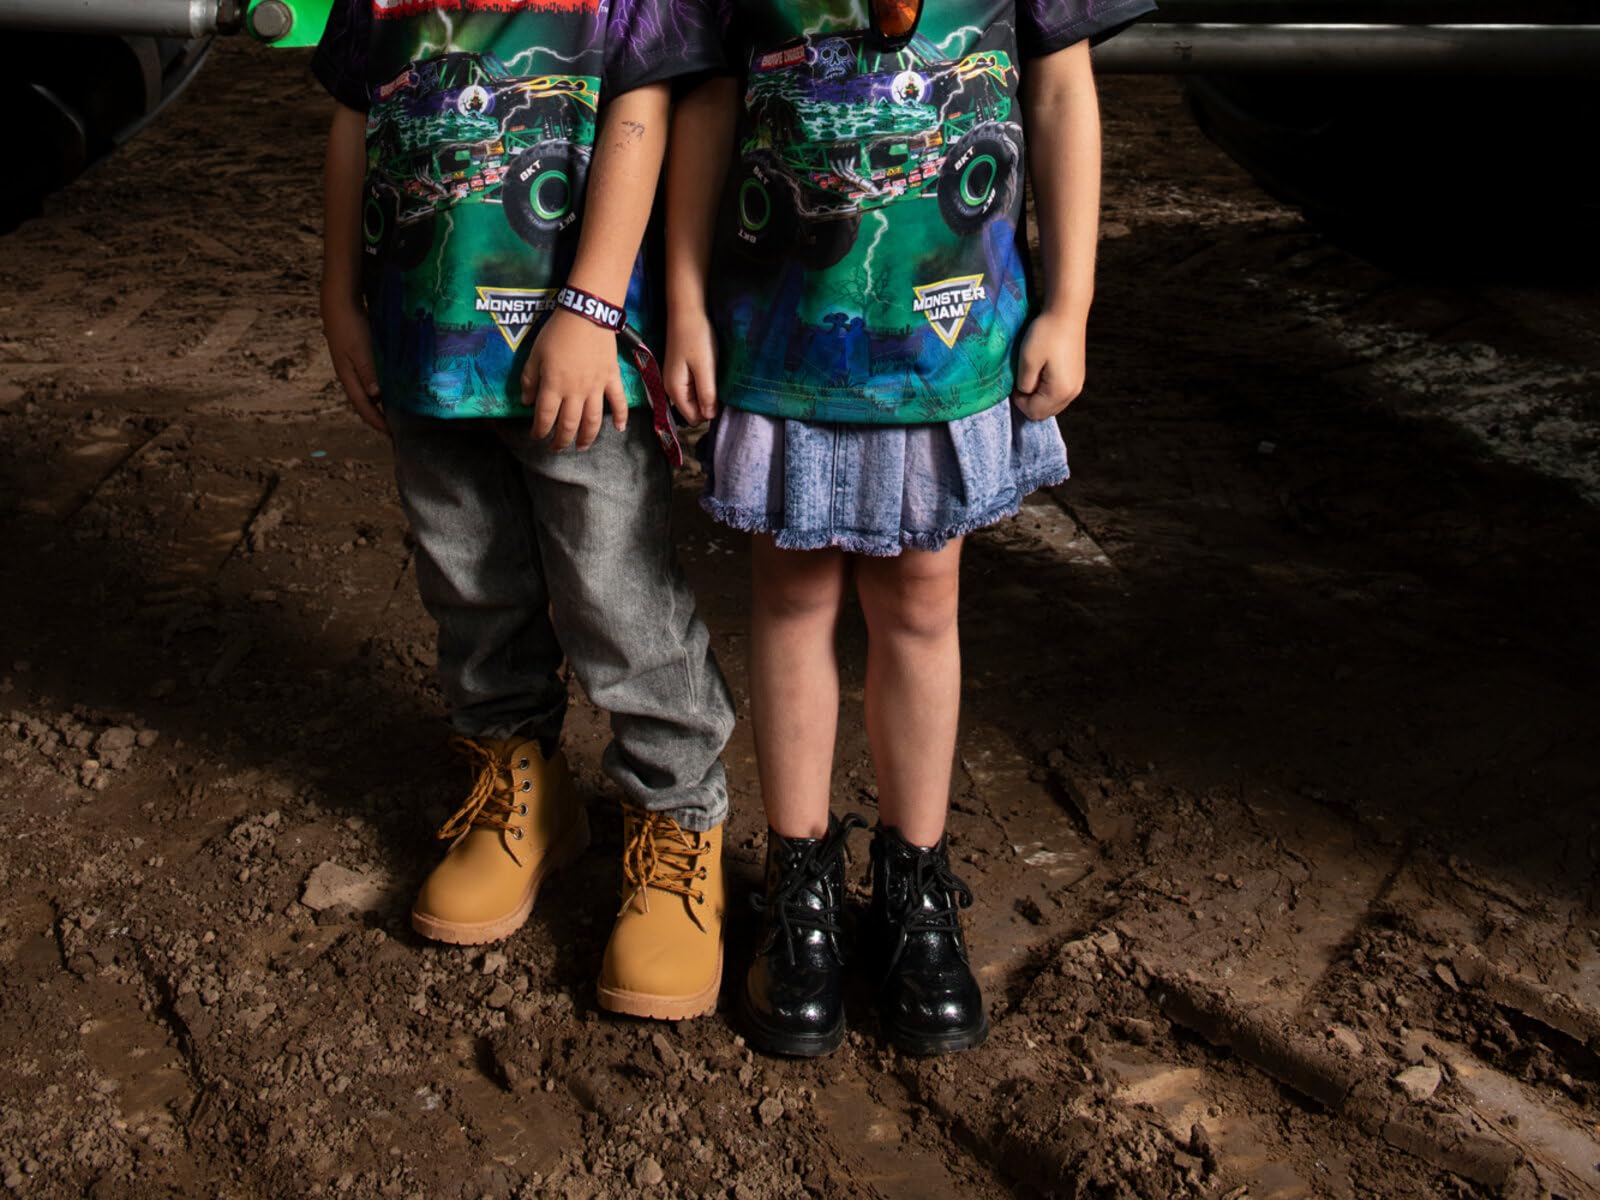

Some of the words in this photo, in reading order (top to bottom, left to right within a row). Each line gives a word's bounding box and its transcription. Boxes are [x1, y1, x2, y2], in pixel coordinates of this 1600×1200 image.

[954, 145, 975, 171] BKT
[519, 160, 542, 182] BKT
[475, 298, 557, 312] MONSTER
[558, 287, 622, 327] ONSTER
[912, 286, 986, 312] MONSTER
[497, 312, 535, 325] JAM
[930, 303, 965, 320] JAM
